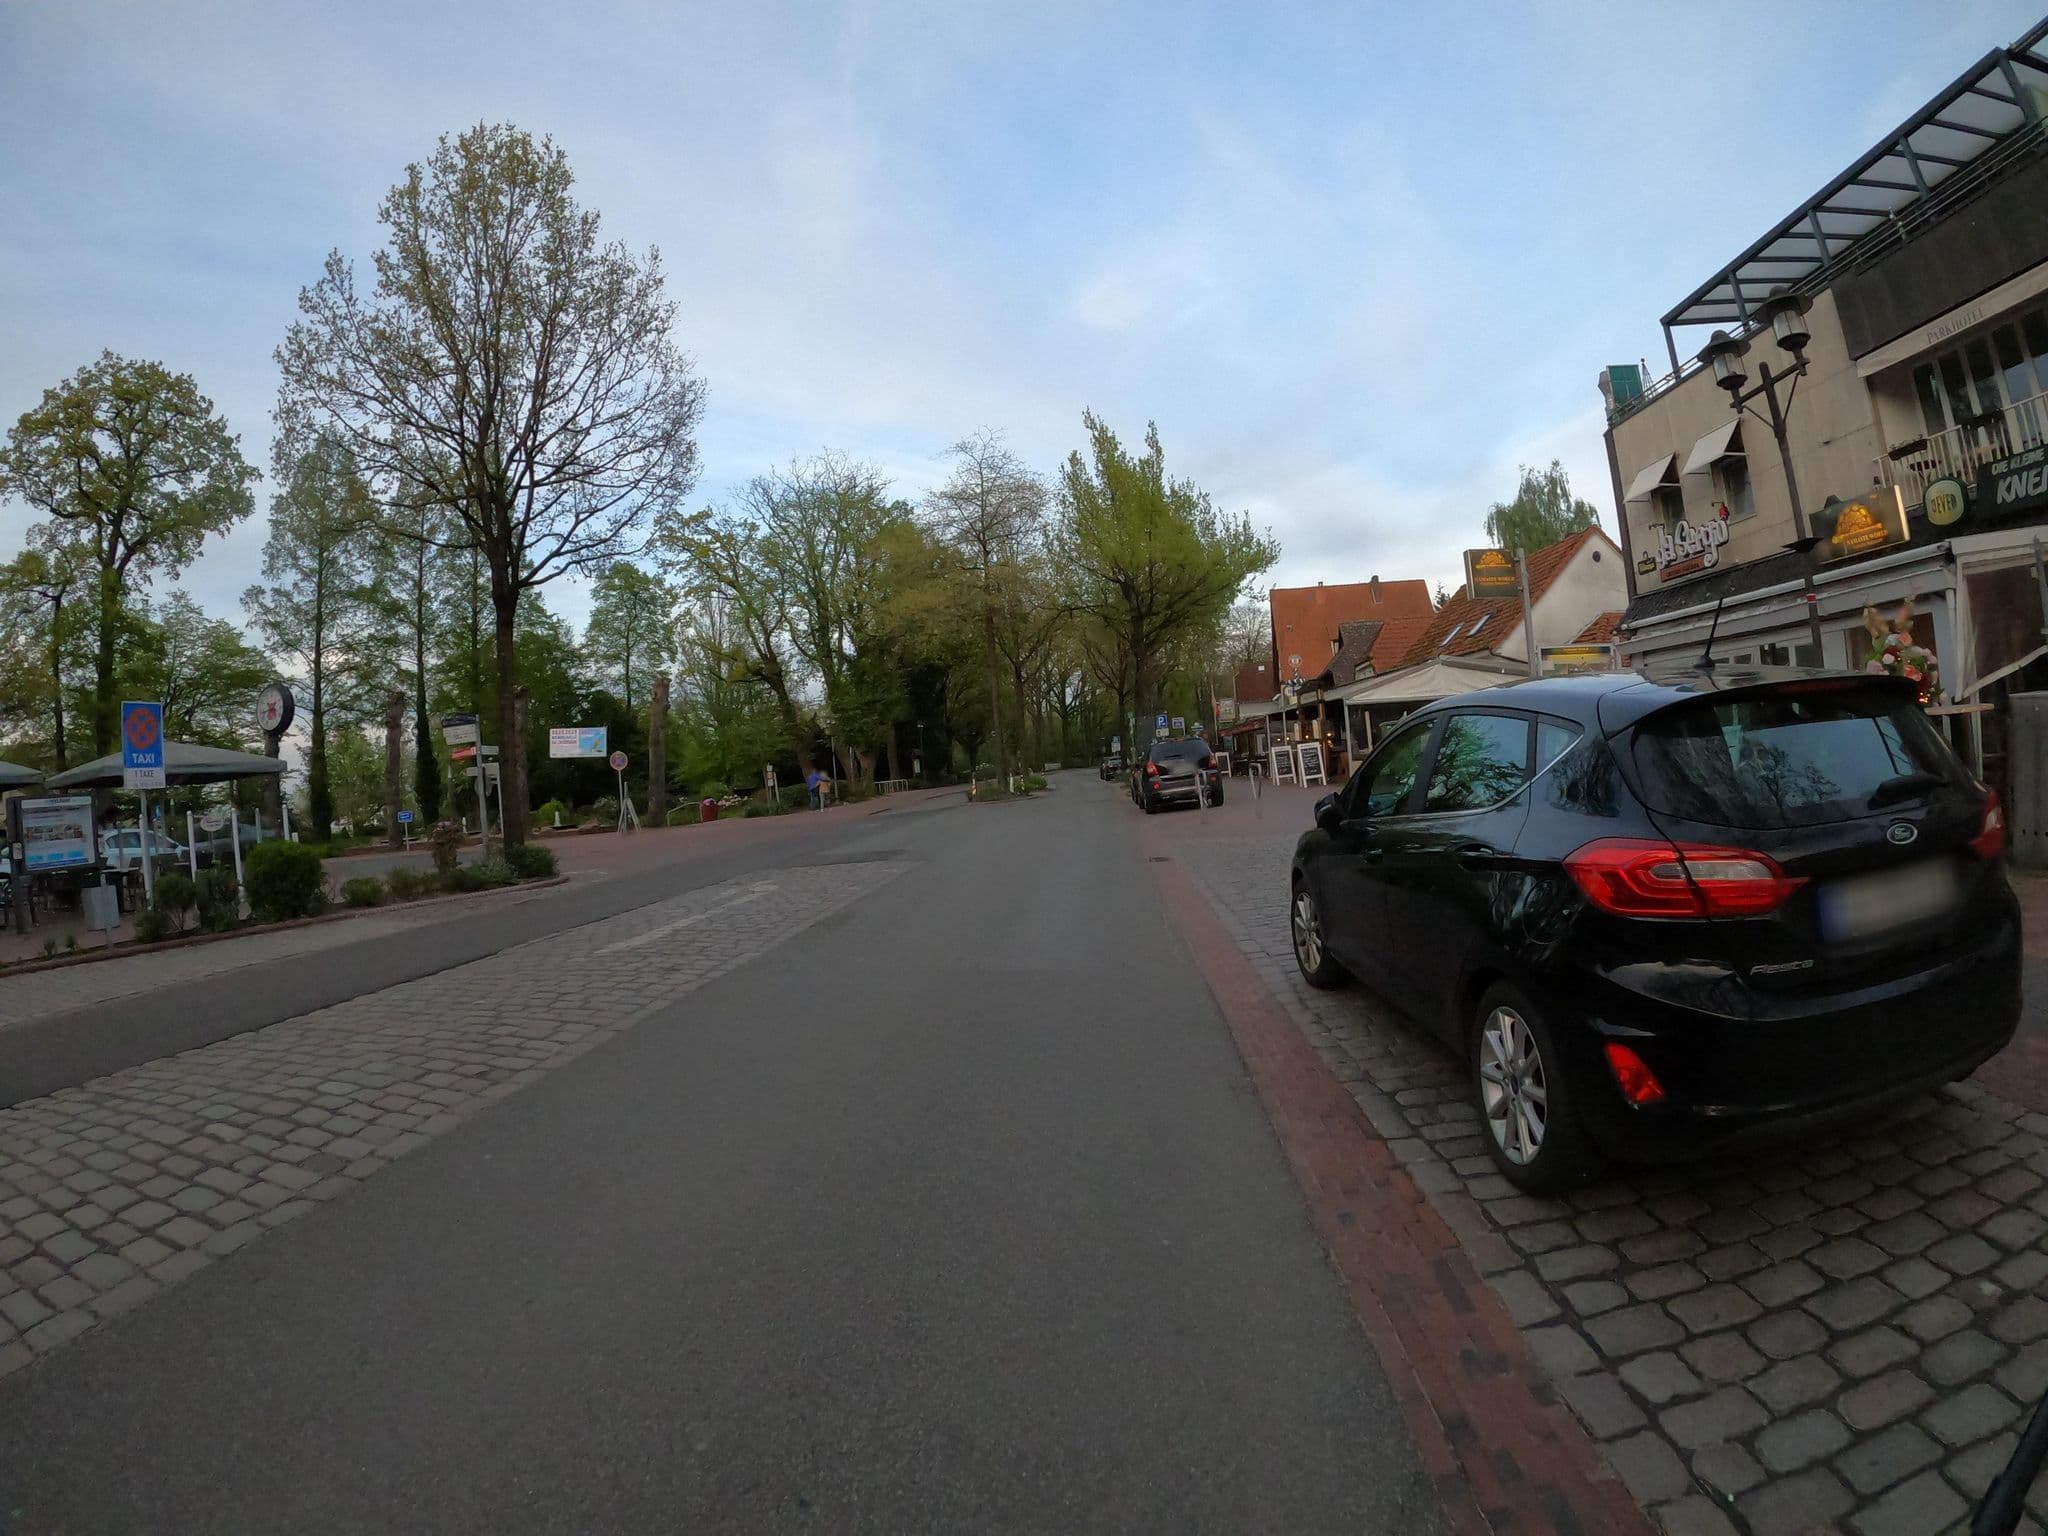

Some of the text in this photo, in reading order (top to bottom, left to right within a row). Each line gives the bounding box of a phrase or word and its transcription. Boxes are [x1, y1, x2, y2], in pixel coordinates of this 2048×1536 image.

[1927, 308, 1986, 344] PARKHOTEL
[1991, 448, 2044, 476] DIE KLEINE
[1930, 493, 1958, 514] JEVER
[1674, 519, 1729, 568] Sergio
[132, 753, 155, 763] TAXI
